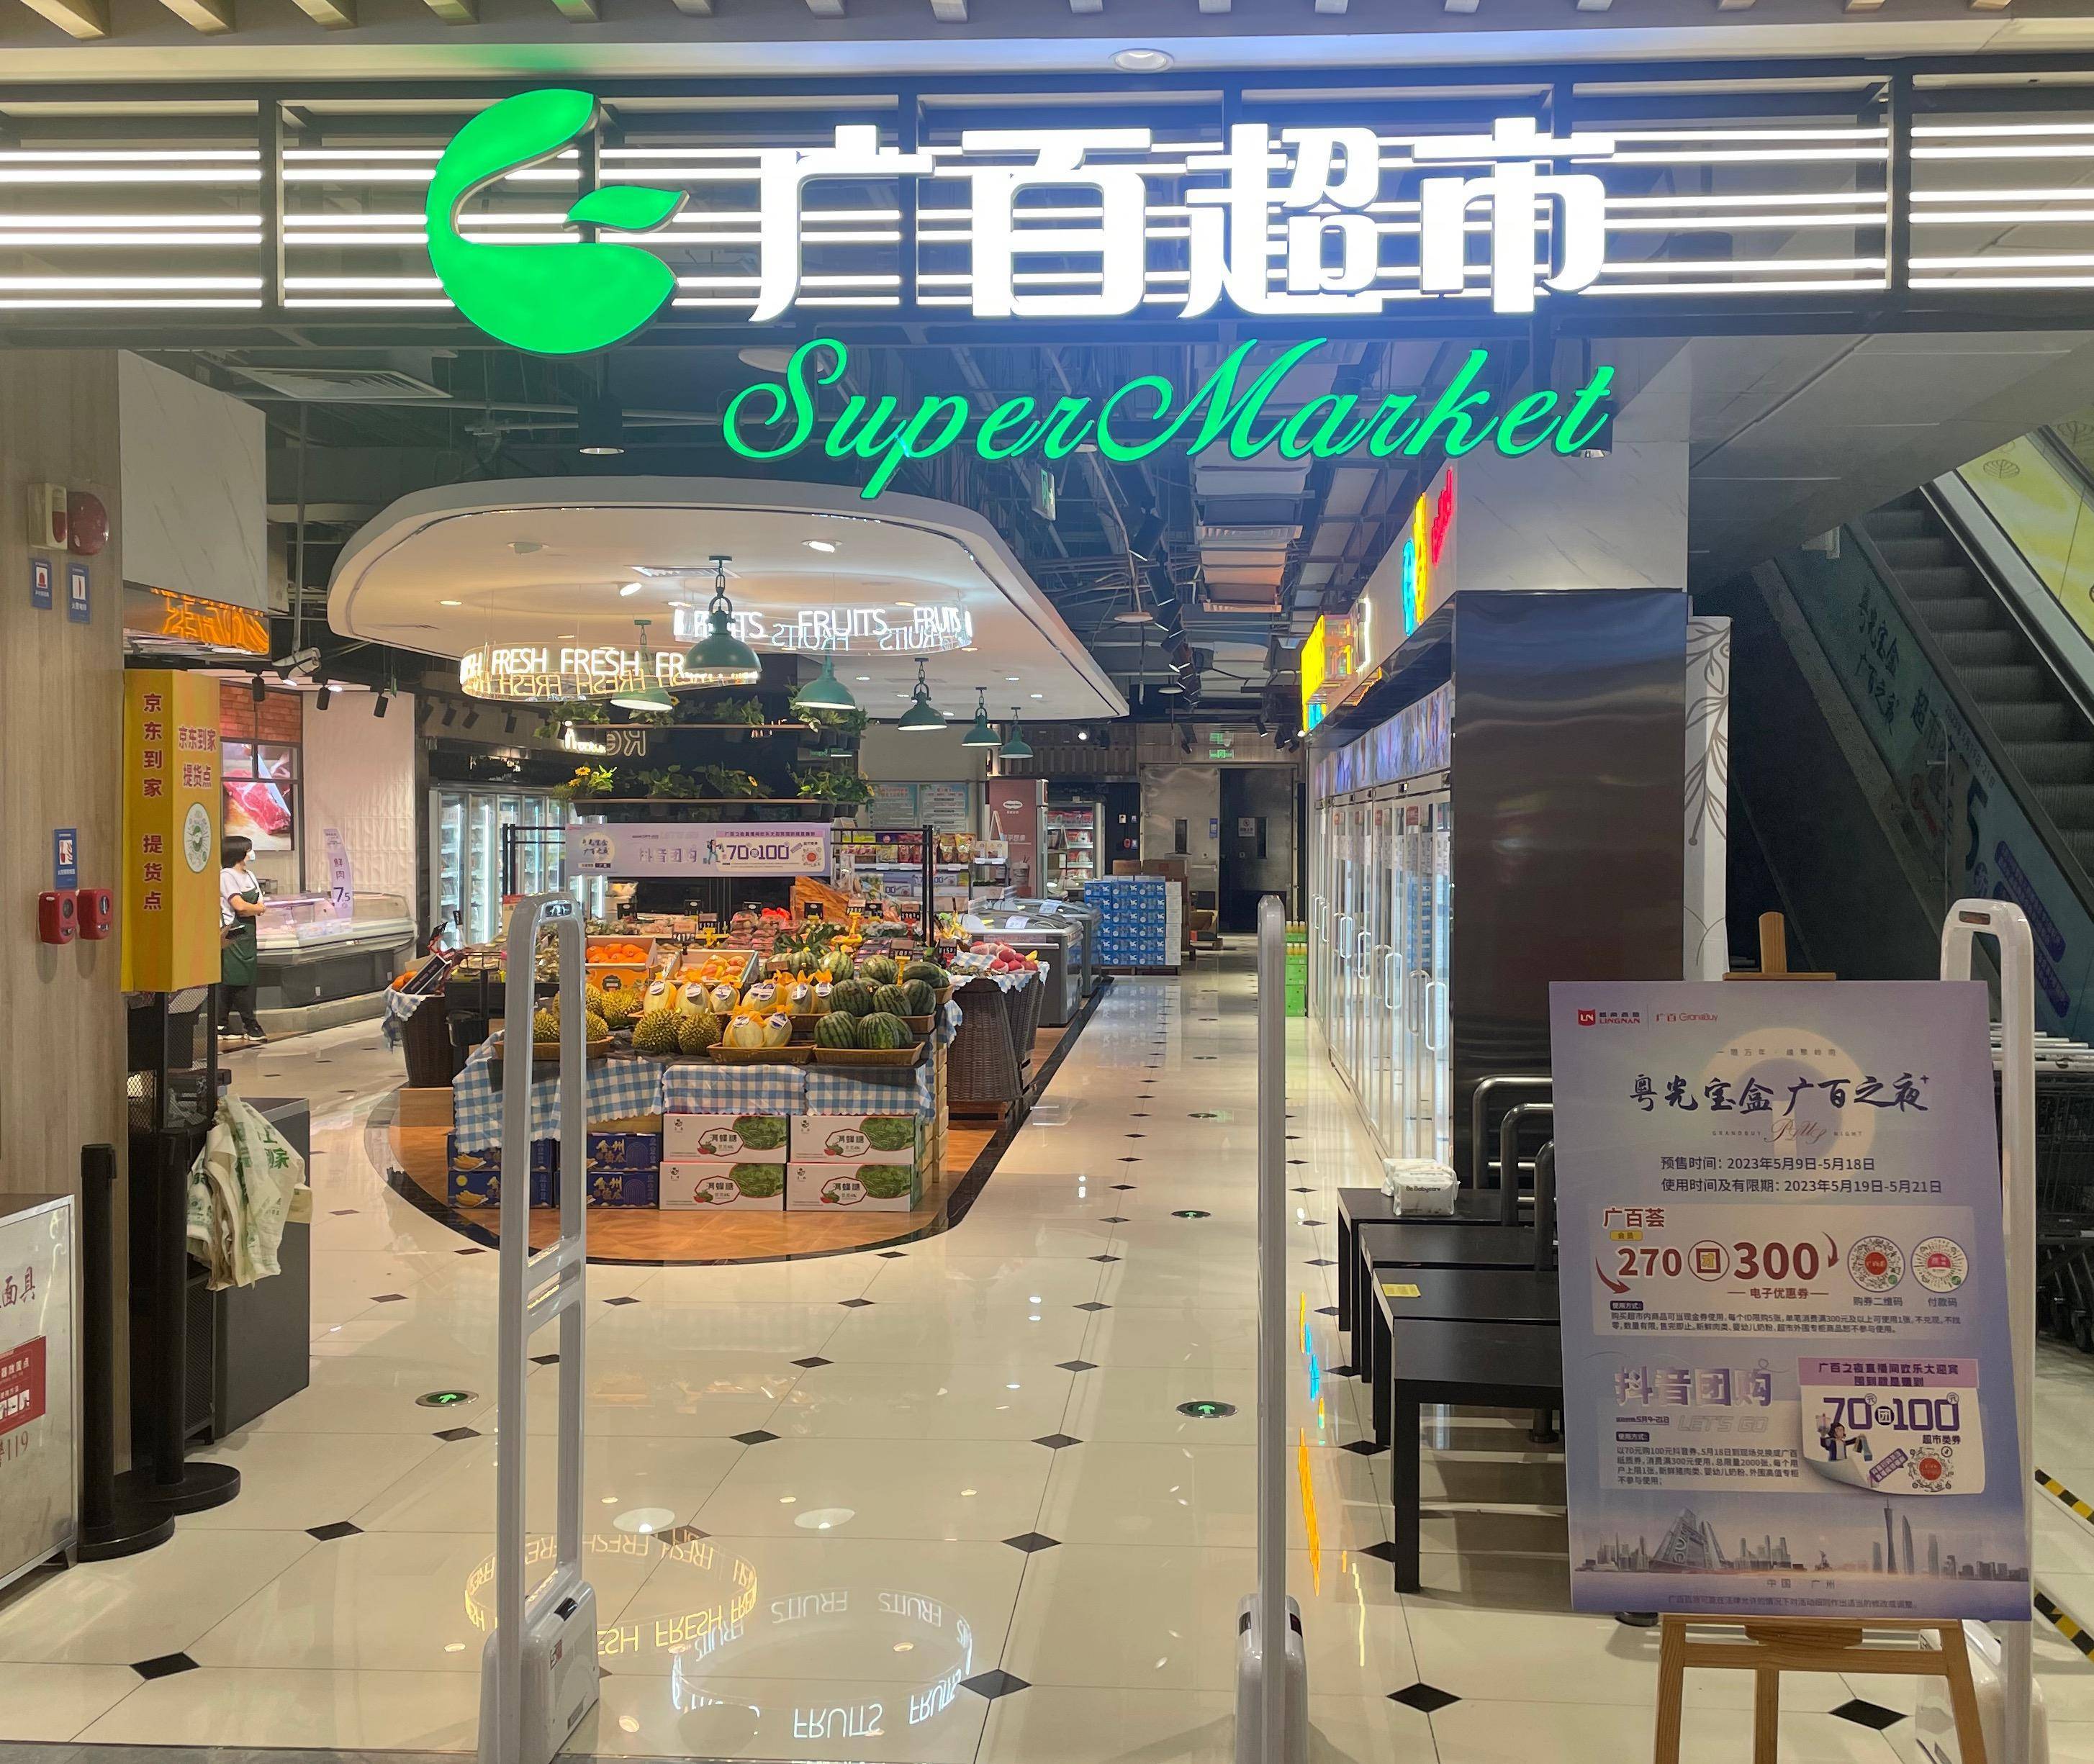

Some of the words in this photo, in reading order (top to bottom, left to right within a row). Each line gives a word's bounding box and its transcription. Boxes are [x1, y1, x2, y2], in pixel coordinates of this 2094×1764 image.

[749, 117, 1615, 322] 广百超市
[723, 337, 1615, 500] SuperMarket
[798, 608, 888, 638] FRUITS
[492, 647, 547, 676] FRESH
[560, 648, 640, 677] FRESH
[143, 692, 163, 797] 京东到家
[178, 725, 217, 752] 京东到家
[183, 764, 212, 789] 提货点
[143, 834, 163, 910] 提货点
[1630, 1074, 1774, 1114] 粤光宝盒
[1782, 1075, 1929, 1116] 广百之夜
[1603, 1208, 1665, 1229] 广百荟
[1617, 1248, 1682, 1277] 270
[1733, 1241, 1819, 1280] 300
[0, 1266, 35, 1308] 面具
[1750, 1288, 1810, 1300] 电子优惠券
[1928, 1298, 1958, 1307] 付款码
[1615, 1366, 1772, 1407] 抖音团购
[1823, 1397, 1872, 1430] 70
[1893, 1398, 1960, 1431] 100
